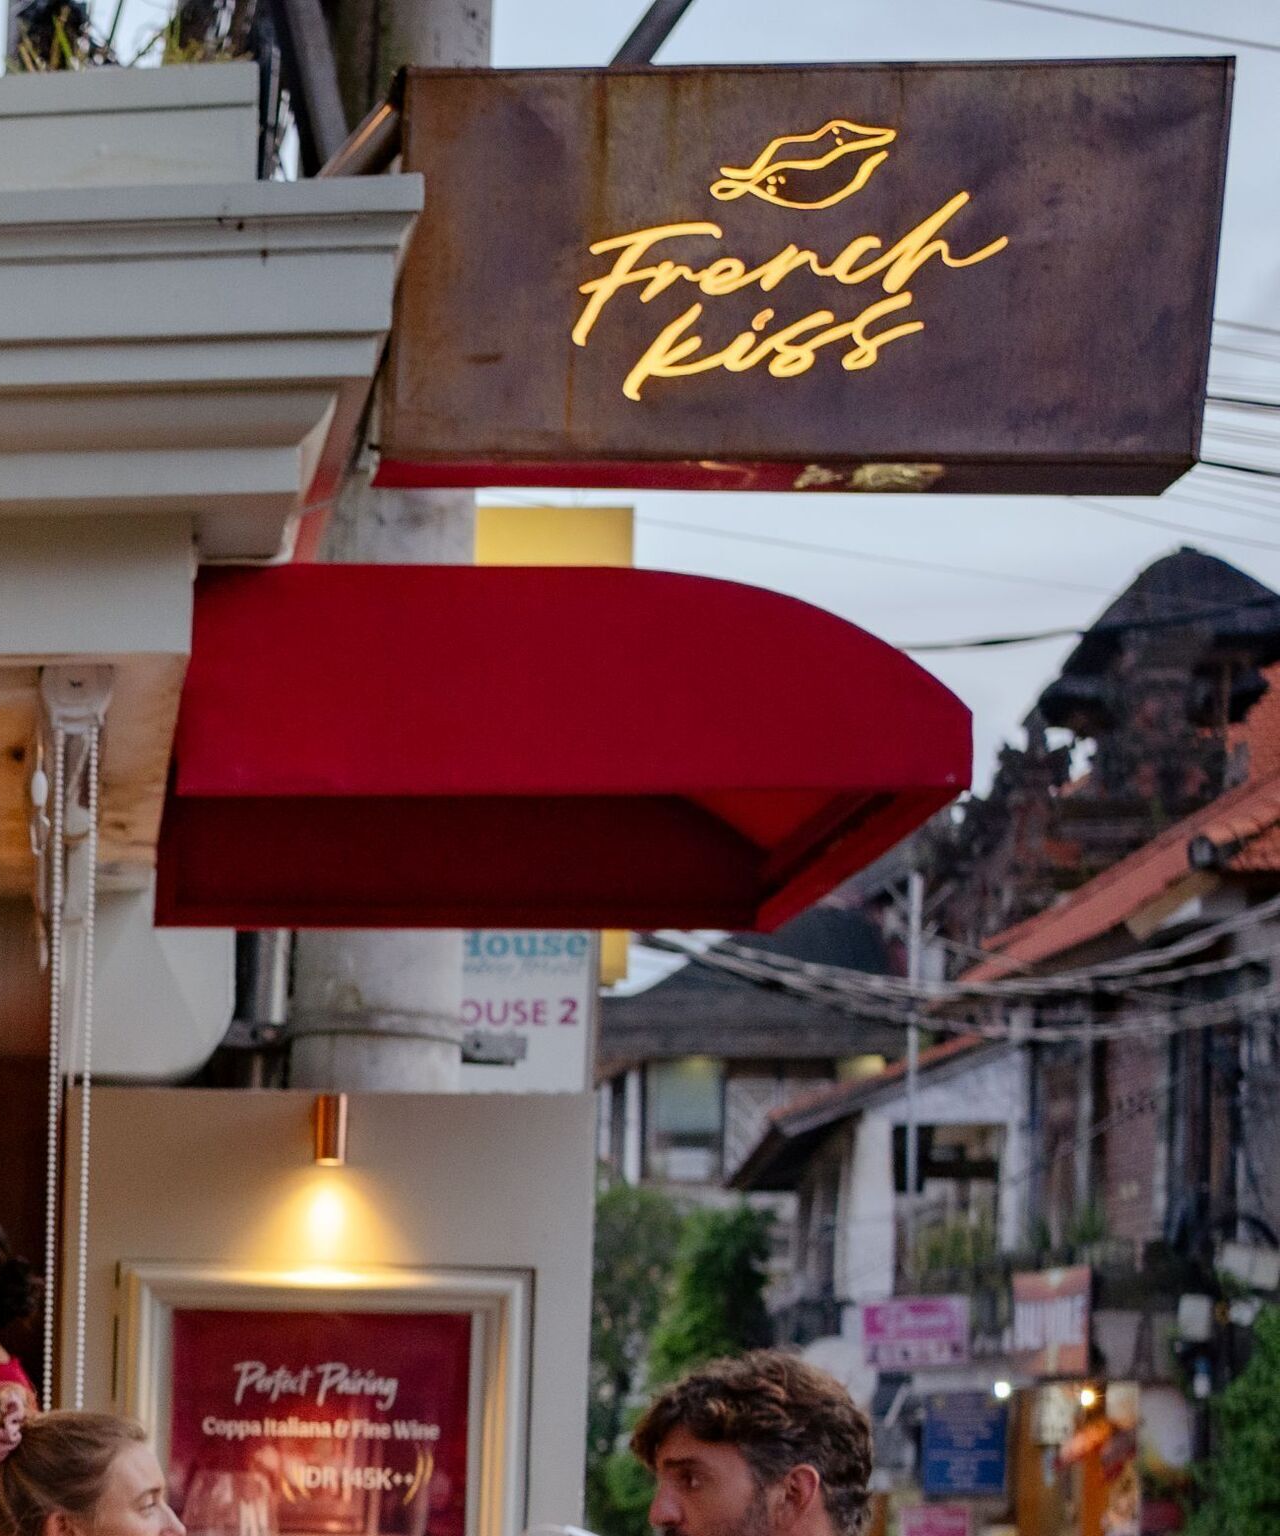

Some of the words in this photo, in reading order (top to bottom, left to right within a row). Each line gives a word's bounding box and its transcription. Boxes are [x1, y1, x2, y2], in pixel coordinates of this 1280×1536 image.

[571, 190, 1009, 347] French
[621, 291, 925, 401] kiss
[559, 998, 578, 1025] 2
[234, 1361, 312, 1406] Perfect
[316, 1362, 399, 1411] Pairing
[202, 1416, 263, 1440] Coppa
[264, 1416, 332, 1438] Italiana
[351, 1418, 391, 1439] Fine
[392, 1420, 440, 1441] Wine
